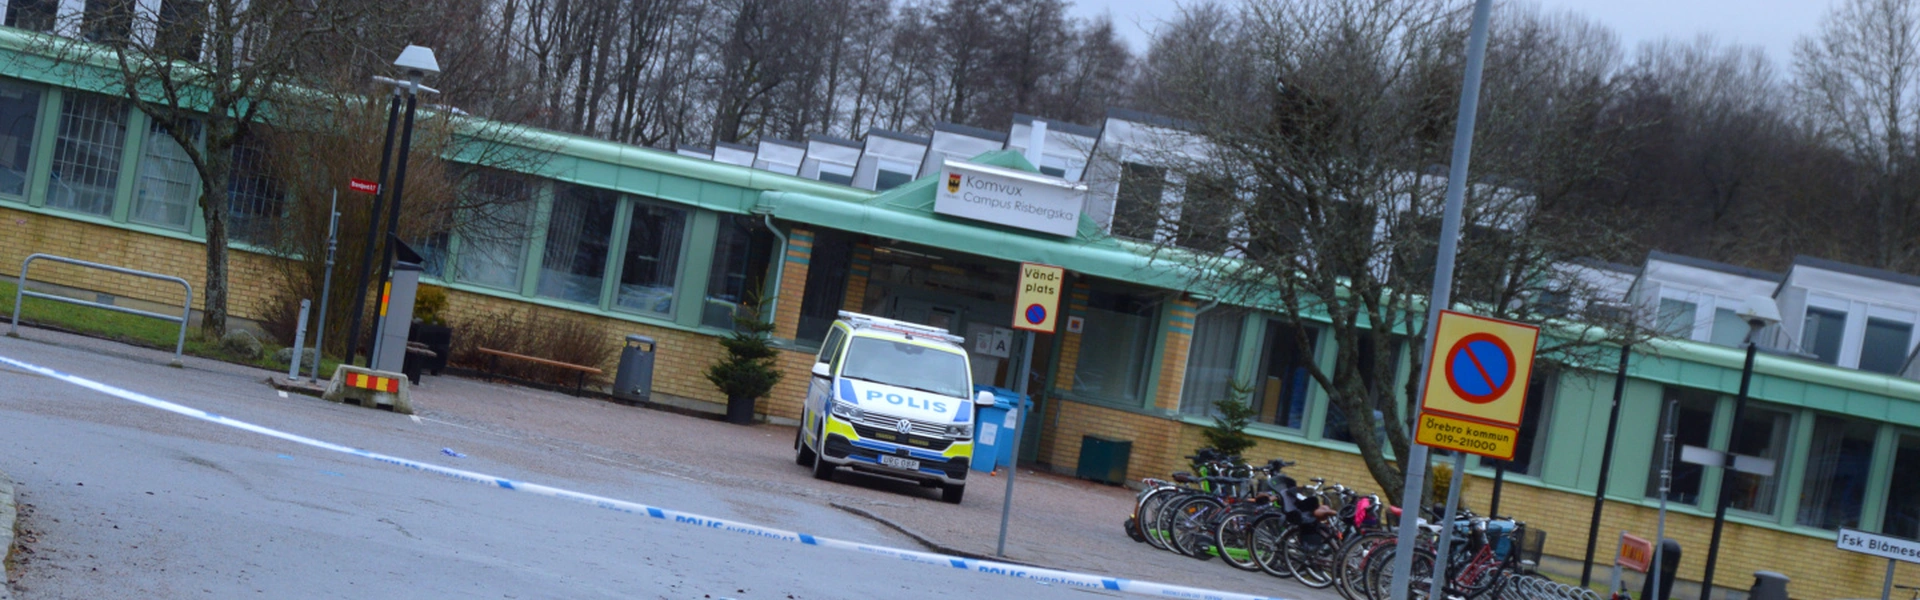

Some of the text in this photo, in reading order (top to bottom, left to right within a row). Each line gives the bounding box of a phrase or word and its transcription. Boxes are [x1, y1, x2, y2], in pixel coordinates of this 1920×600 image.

[966, 175, 1023, 197] Komvux
[963, 191, 1074, 221] Campus Risbergska
[1024, 267, 1060, 281] Vänd-
[1025, 283, 1054, 295] plats
[996, 339, 1006, 352] A
[866, 390, 947, 413] POLIS
[1426, 417, 1509, 442] Örebro kommun
[1435, 433, 1497, 451] 019-211000
[1842, 534, 1864, 547] Fsk
